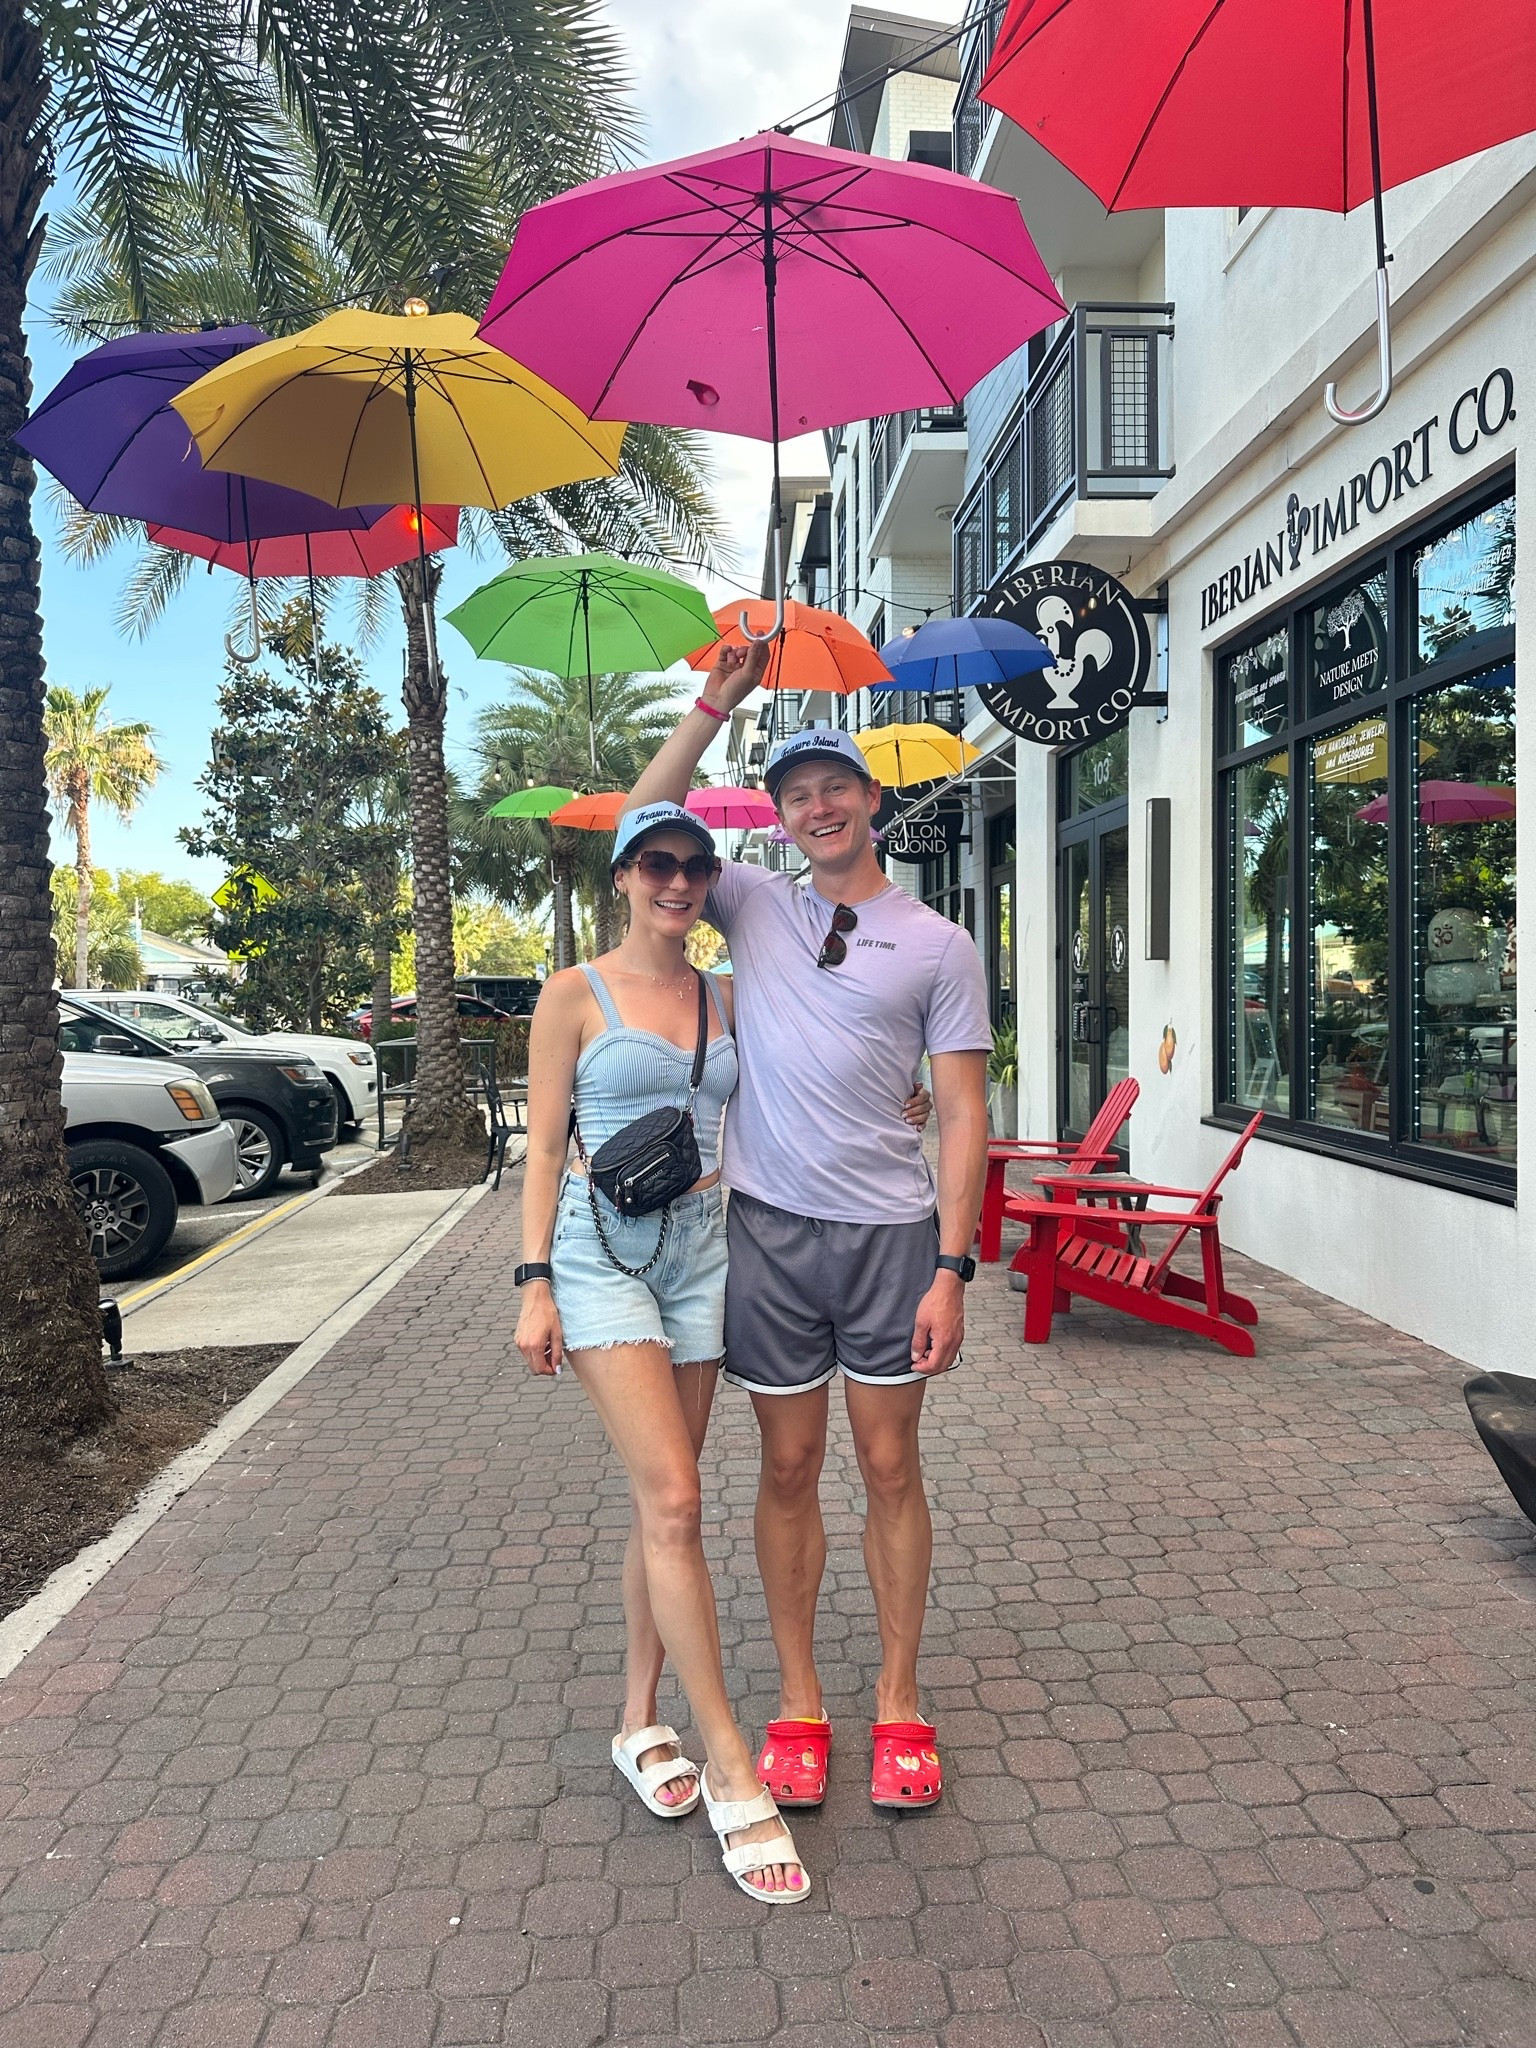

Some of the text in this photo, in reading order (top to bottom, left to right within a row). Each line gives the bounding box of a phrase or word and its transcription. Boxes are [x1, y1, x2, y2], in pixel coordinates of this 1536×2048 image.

[1201, 367, 1516, 630] IBERIAN IMPORT CO.
[1003, 565, 1122, 607] IBERIAN
[1320, 647, 1379, 687] NATURE MEETS
[1333, 674, 1364, 700] DESIGN
[987, 687, 1137, 741] IMPORT CO.
[812, 735, 840, 748] Island
[1360, 721, 1387, 742] JEWELRY
[1338, 742, 1375, 766] ACCESSORIES
[1093, 757, 1110, 787] 103
[635, 810, 673, 825] Treasure
[674, 809, 697, 824] Island
[856, 938, 897, 951] LIFE TIME
